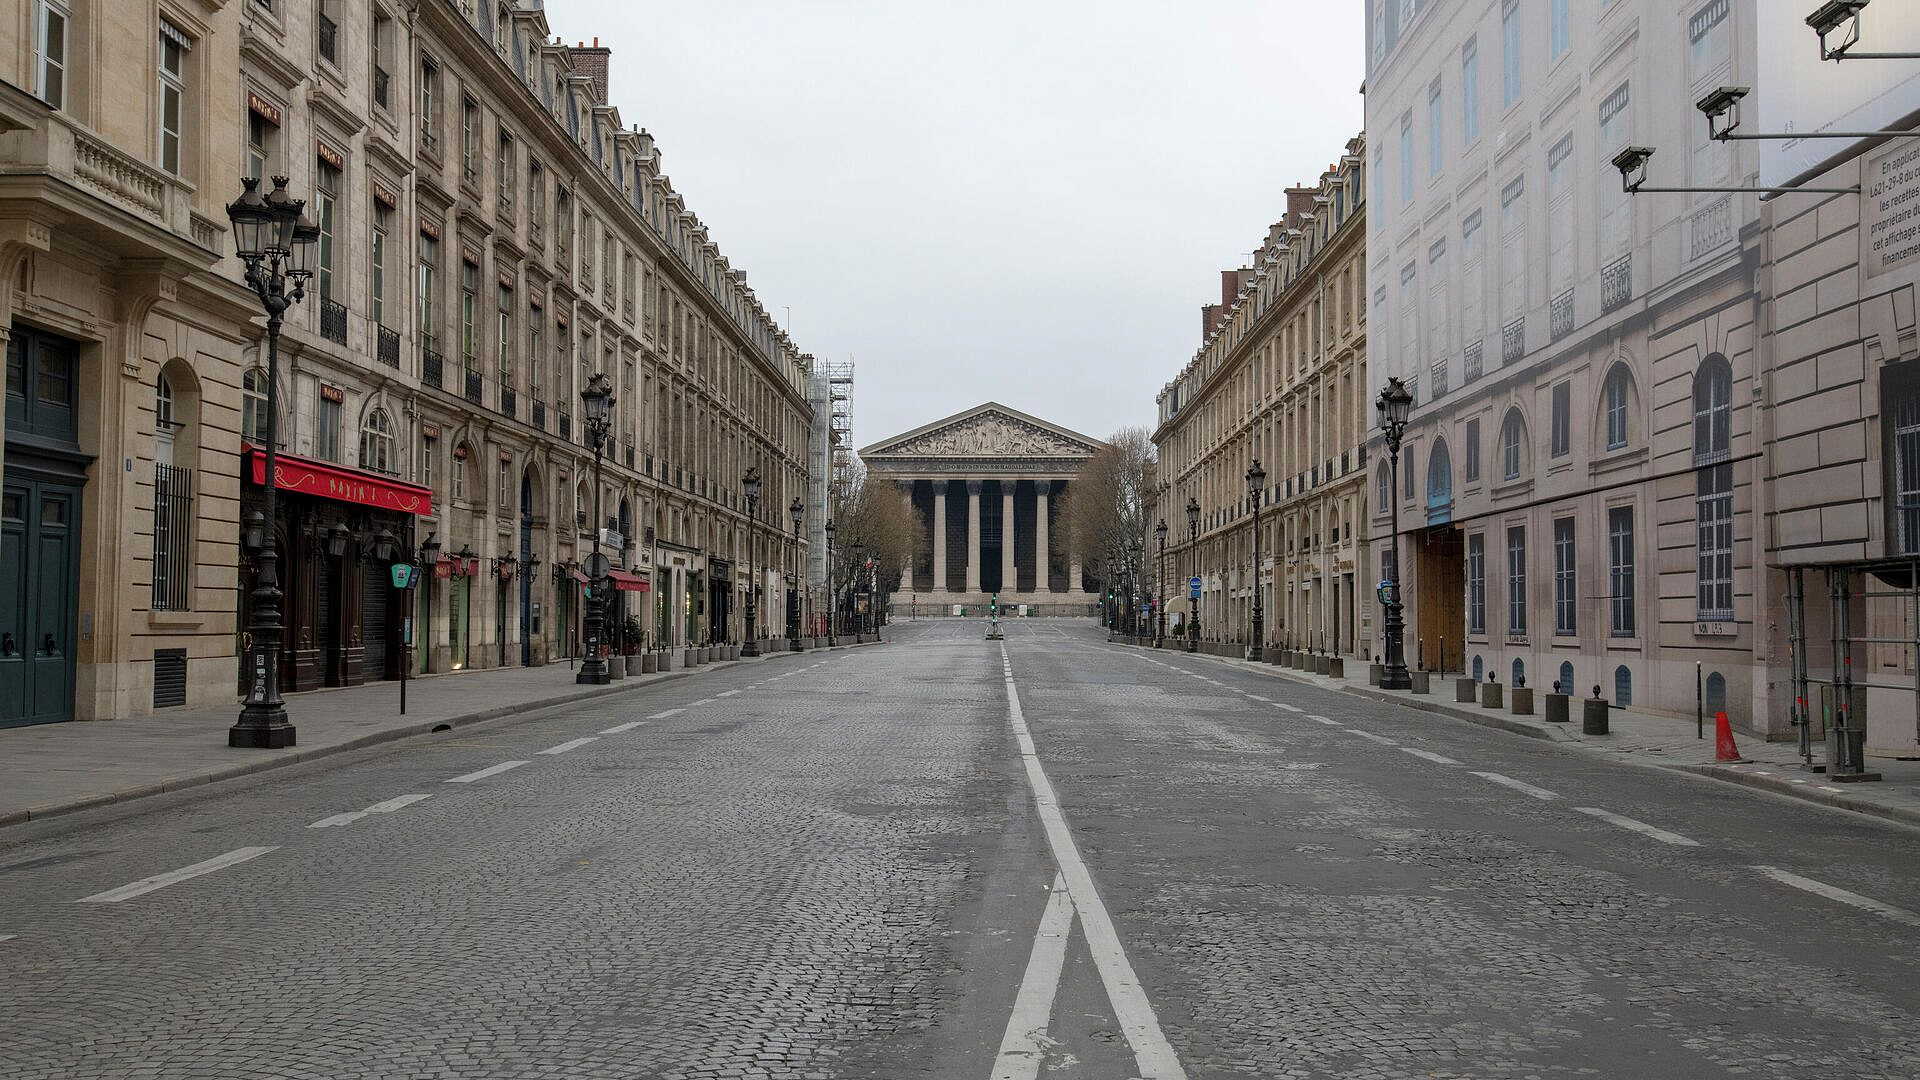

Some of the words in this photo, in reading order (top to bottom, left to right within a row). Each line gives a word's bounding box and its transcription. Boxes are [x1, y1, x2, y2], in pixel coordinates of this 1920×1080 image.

[1882, 162, 1891, 175] En
[1870, 172, 1903, 198] L621-29-8
[1904, 169, 1913, 182] du
[1879, 200, 1889, 212] les
[1891, 186, 1919, 208] recettes
[1871, 209, 1911, 236] propriétaire
[1873, 238, 1883, 251] cet
[1885, 226, 1916, 247] affichage
